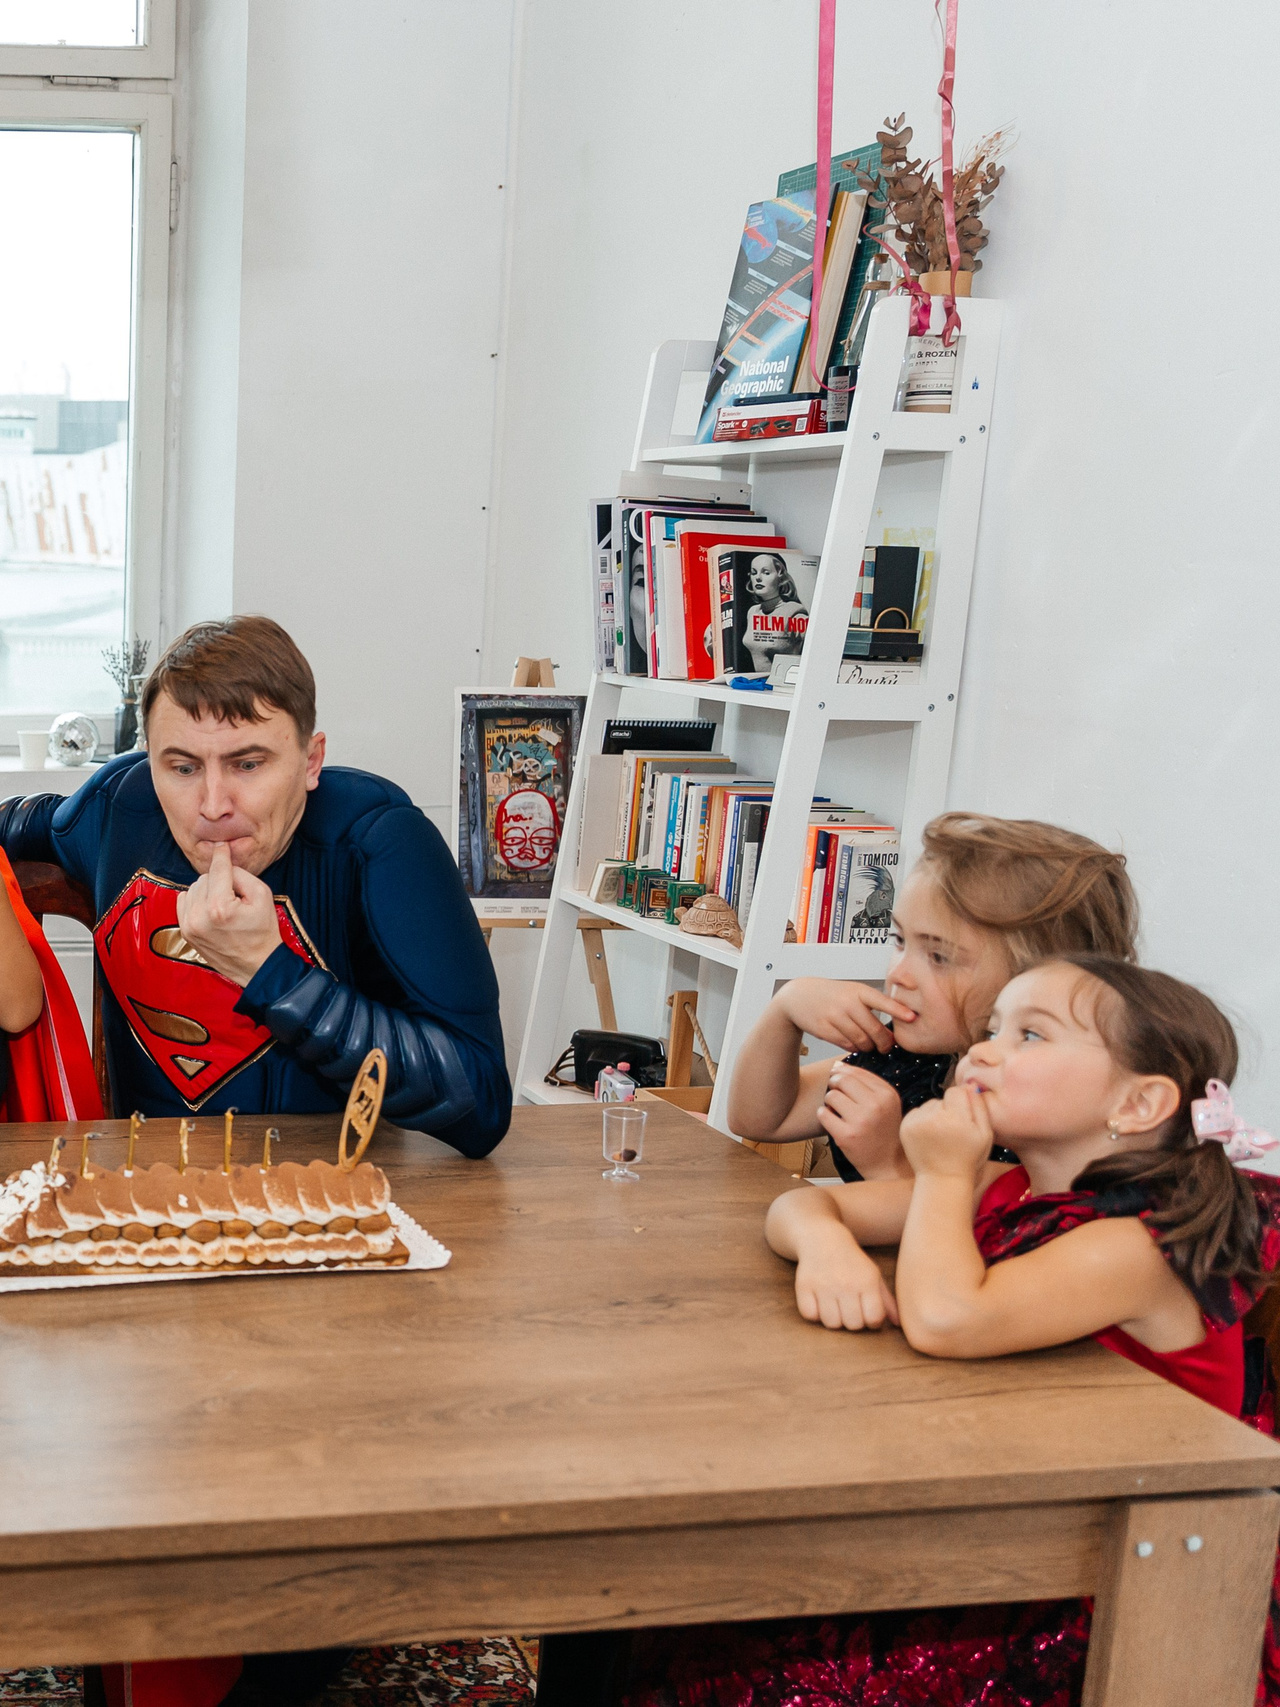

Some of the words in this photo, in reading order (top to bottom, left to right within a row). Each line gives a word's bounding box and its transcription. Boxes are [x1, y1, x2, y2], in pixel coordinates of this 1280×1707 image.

[924, 350, 958, 358] ROZEN
[739, 355, 790, 377] National
[720, 377, 785, 399] Geographic
[717, 420, 735, 431] Spark
[753, 615, 784, 632] FILM
[674, 805, 684, 842] TALKS
[863, 853, 899, 866] ТОМПСО
[850, 929, 889, 938] ЦАРСТВ
